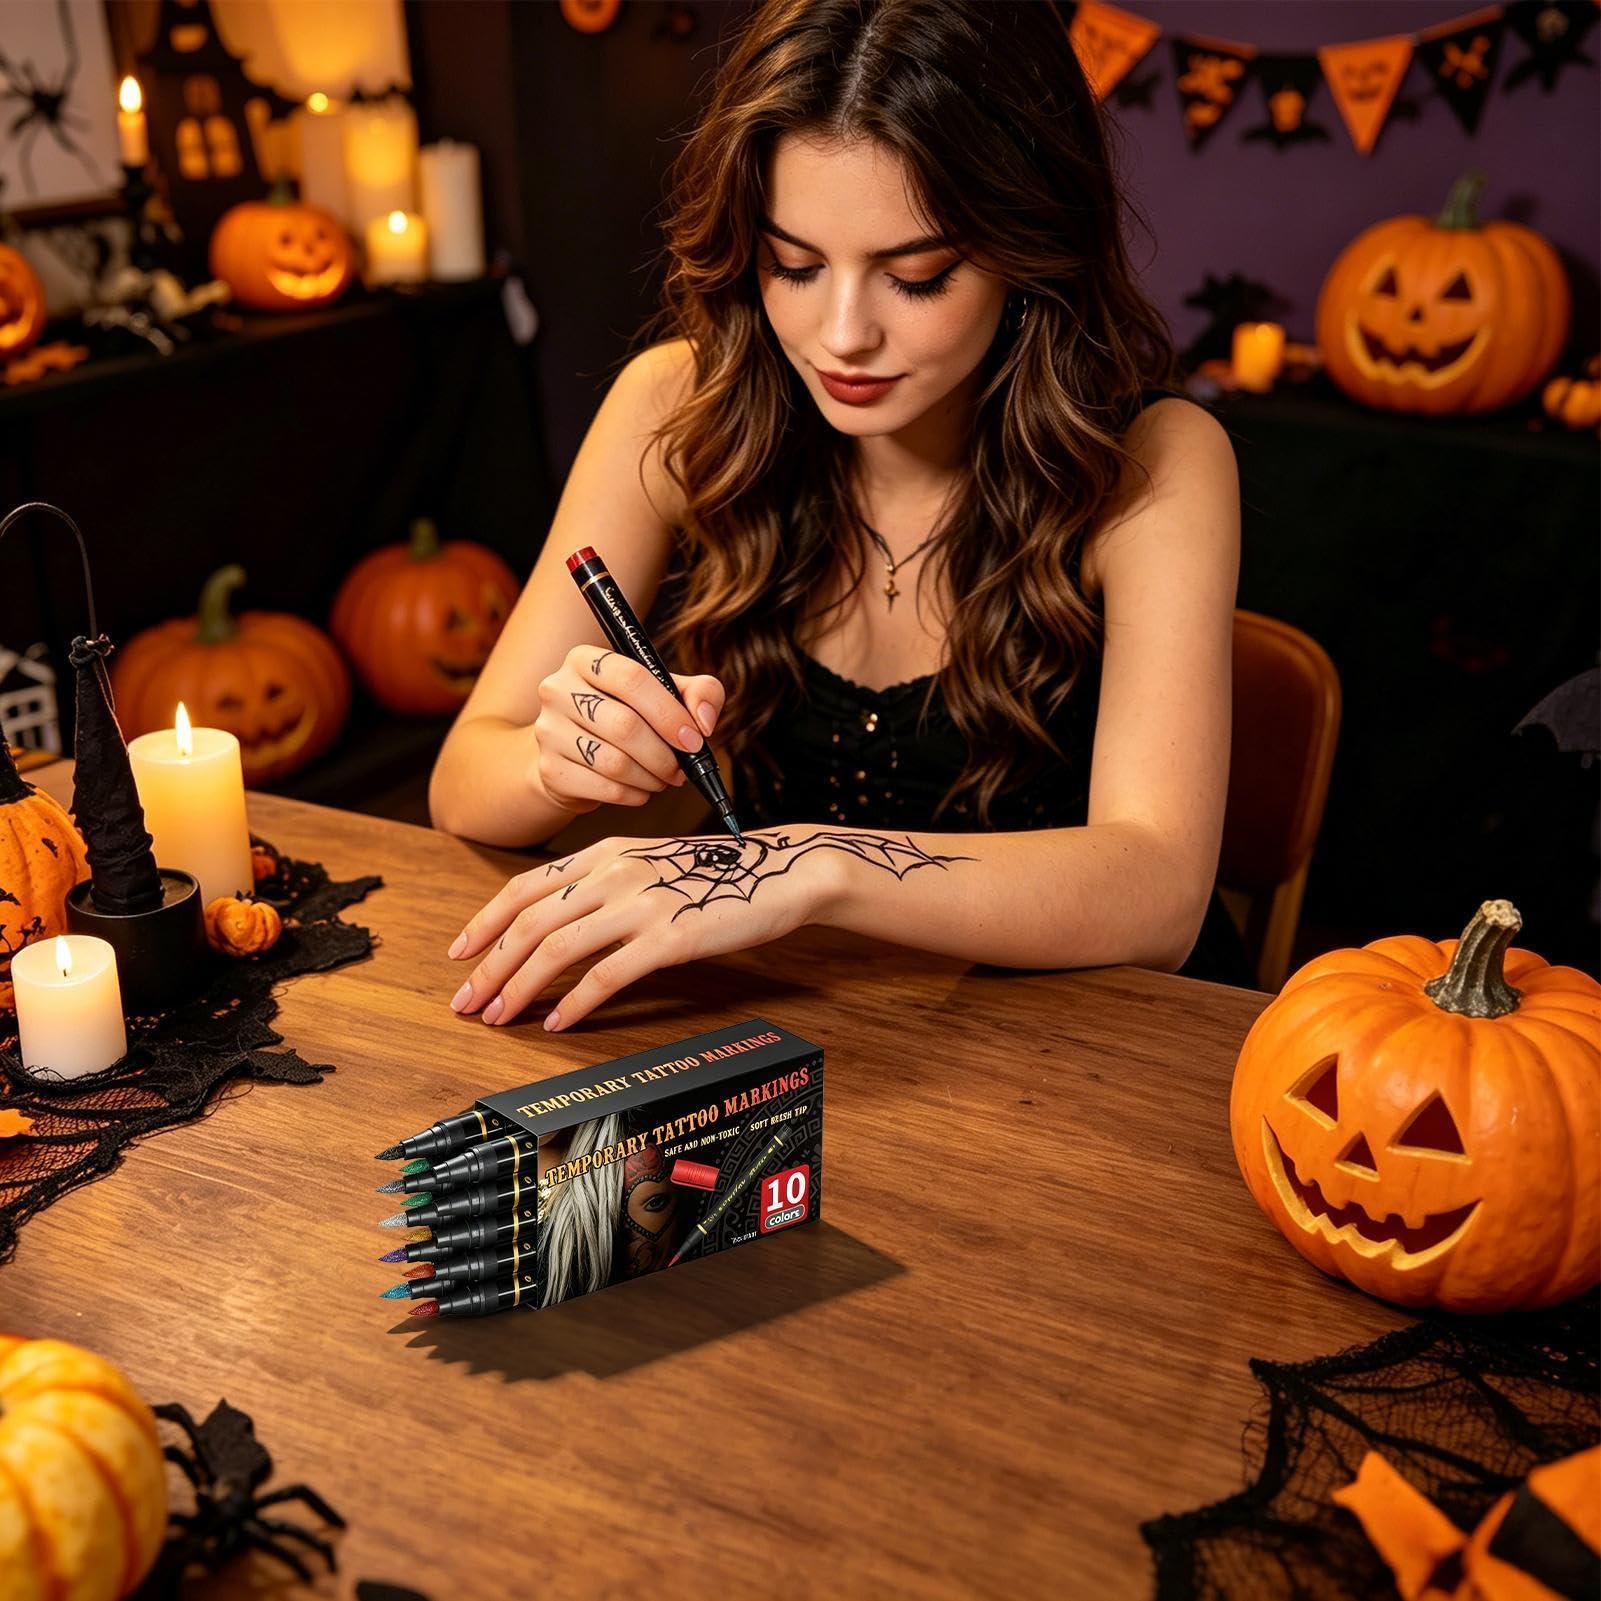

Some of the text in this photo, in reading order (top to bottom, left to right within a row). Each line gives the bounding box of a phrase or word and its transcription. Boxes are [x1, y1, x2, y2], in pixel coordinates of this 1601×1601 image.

[516, 1031, 782, 1118] TEMPORARY TATTOO MARKINGS
[545, 1067, 810, 1188] TEMPORARY TATTOO MARKINGS
[750, 1118, 769, 1132] SOFT
[794, 1105, 808, 1117] TIP
[664, 1143, 683, 1158] SAFE
[700, 1126, 740, 1147] NON-TOXIC
[767, 1171, 806, 1213] 10
[769, 1209, 800, 1226] colors
